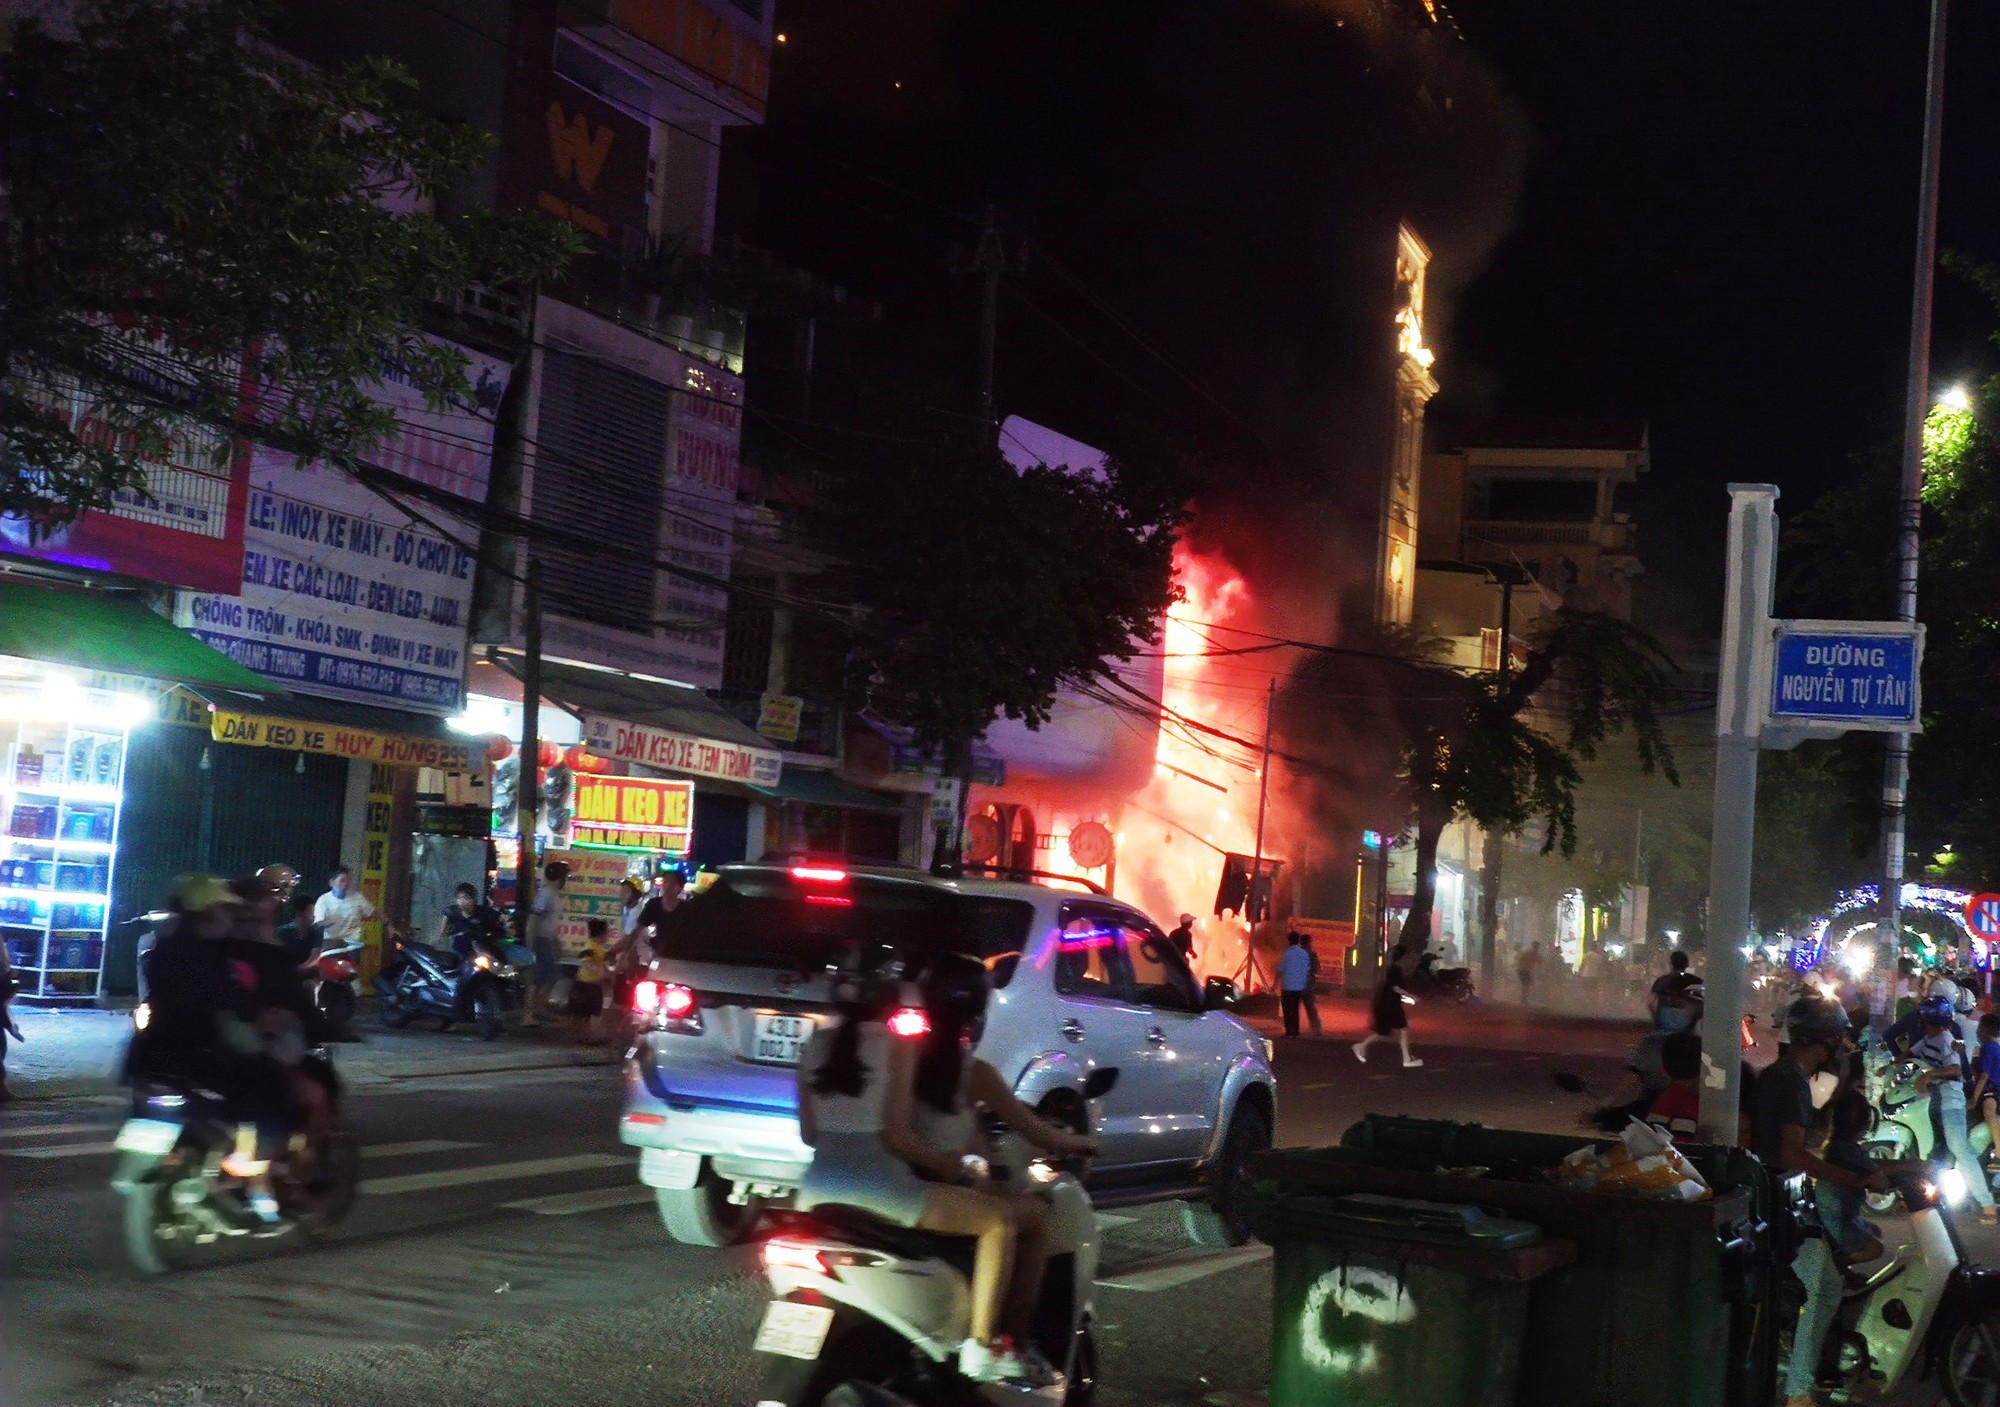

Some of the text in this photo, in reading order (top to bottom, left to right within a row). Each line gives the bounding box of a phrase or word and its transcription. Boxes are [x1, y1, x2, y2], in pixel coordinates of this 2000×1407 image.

[281, 501, 322, 542] INOX
[324, 511, 346, 548] XE
[350, 514, 384, 557] MÁY
[245, 551, 268, 583] EM
[270, 556, 291, 591] XE
[294, 555, 322, 596] CÁC
[326, 569, 359, 614] LOẠI
[247, 606, 285, 640] TRỘM
[296, 616, 331, 645] KHÓA
[335, 627, 361, 651] SMK
[416, 644, 432, 665] XE
[1806, 641, 1885, 668] ĐƯỜNG
[1782, 667, 1907, 709] NGUYỄN TỰ TÂN
[223, 716, 258, 740] DÁN
[303, 731, 325, 750] XE
[334, 732, 375, 758] HUY
[615, 723, 648, 760] DÁN
[650, 735, 675, 764] KEO
[577, 779, 687, 826] DÁN KEO XE
